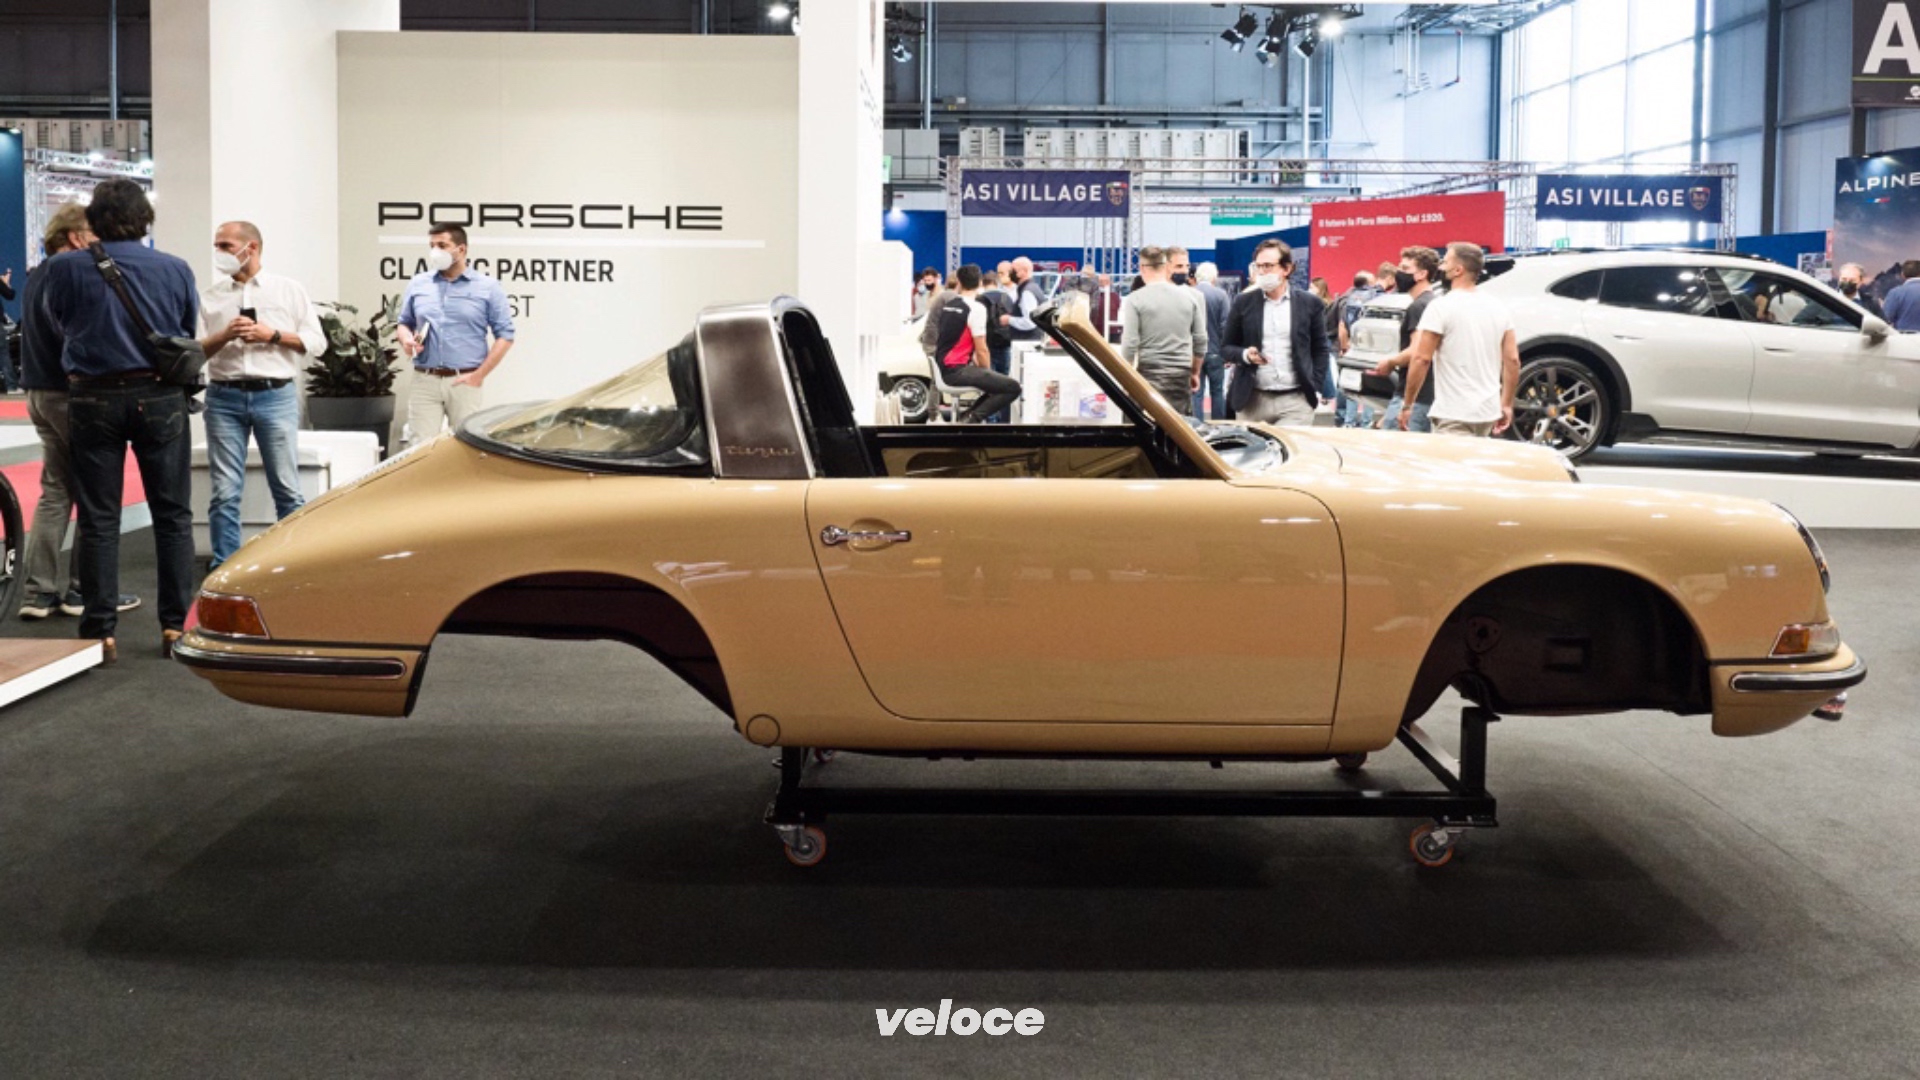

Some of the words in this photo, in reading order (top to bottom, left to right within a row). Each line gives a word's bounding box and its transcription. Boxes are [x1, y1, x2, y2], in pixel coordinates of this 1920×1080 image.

[963, 183, 999, 201] ASI
[1006, 183, 1103, 202] VILLAGE
[1839, 171, 1920, 194] ALPINE
[1545, 187, 1583, 206] ASI
[1589, 188, 1685, 207] VILLAGE
[378, 202, 723, 230] PORSCHE
[380, 257, 490, 280] CLAC
[497, 258, 614, 282] PARTNER
